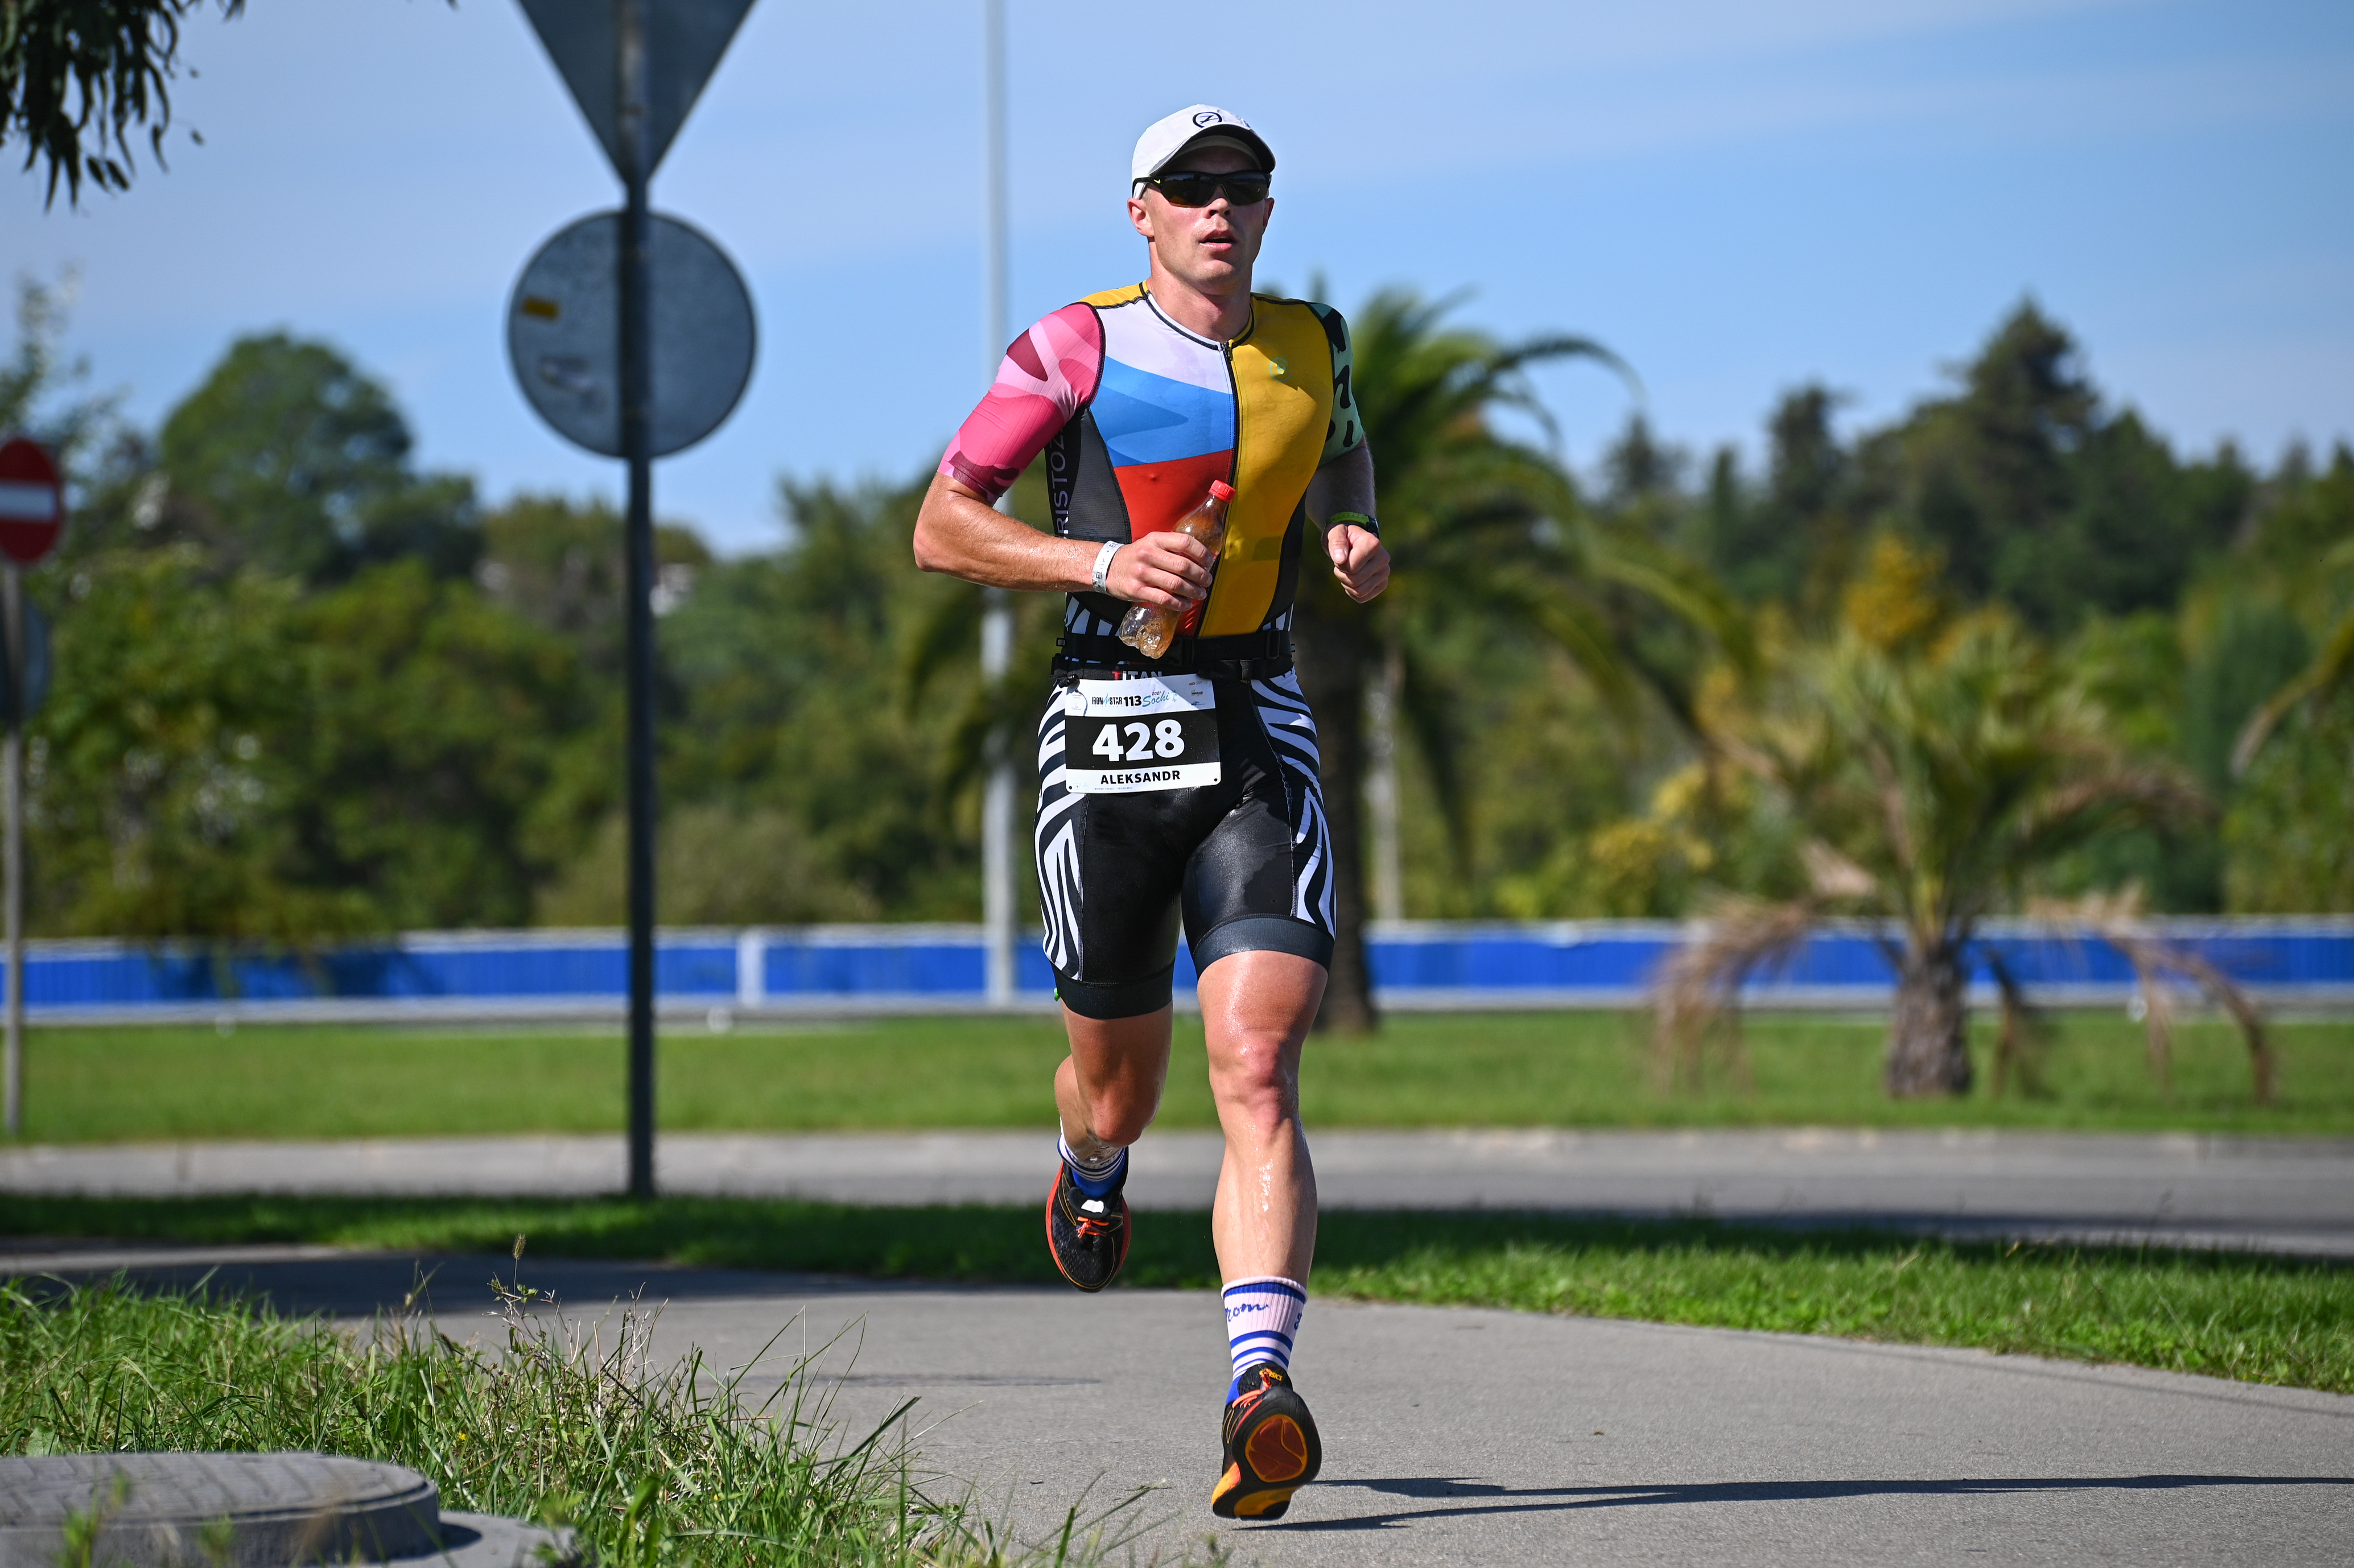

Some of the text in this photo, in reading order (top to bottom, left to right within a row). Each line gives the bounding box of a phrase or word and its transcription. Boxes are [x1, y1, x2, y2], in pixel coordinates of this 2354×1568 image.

[1050, 428, 1069, 539] RISTOZ
[1124, 695, 1142, 707] 113
[1142, 690, 1170, 707] Sochi
[1093, 719, 1185, 762] 428
[1100, 770, 1180, 785] ALEKSANDR
